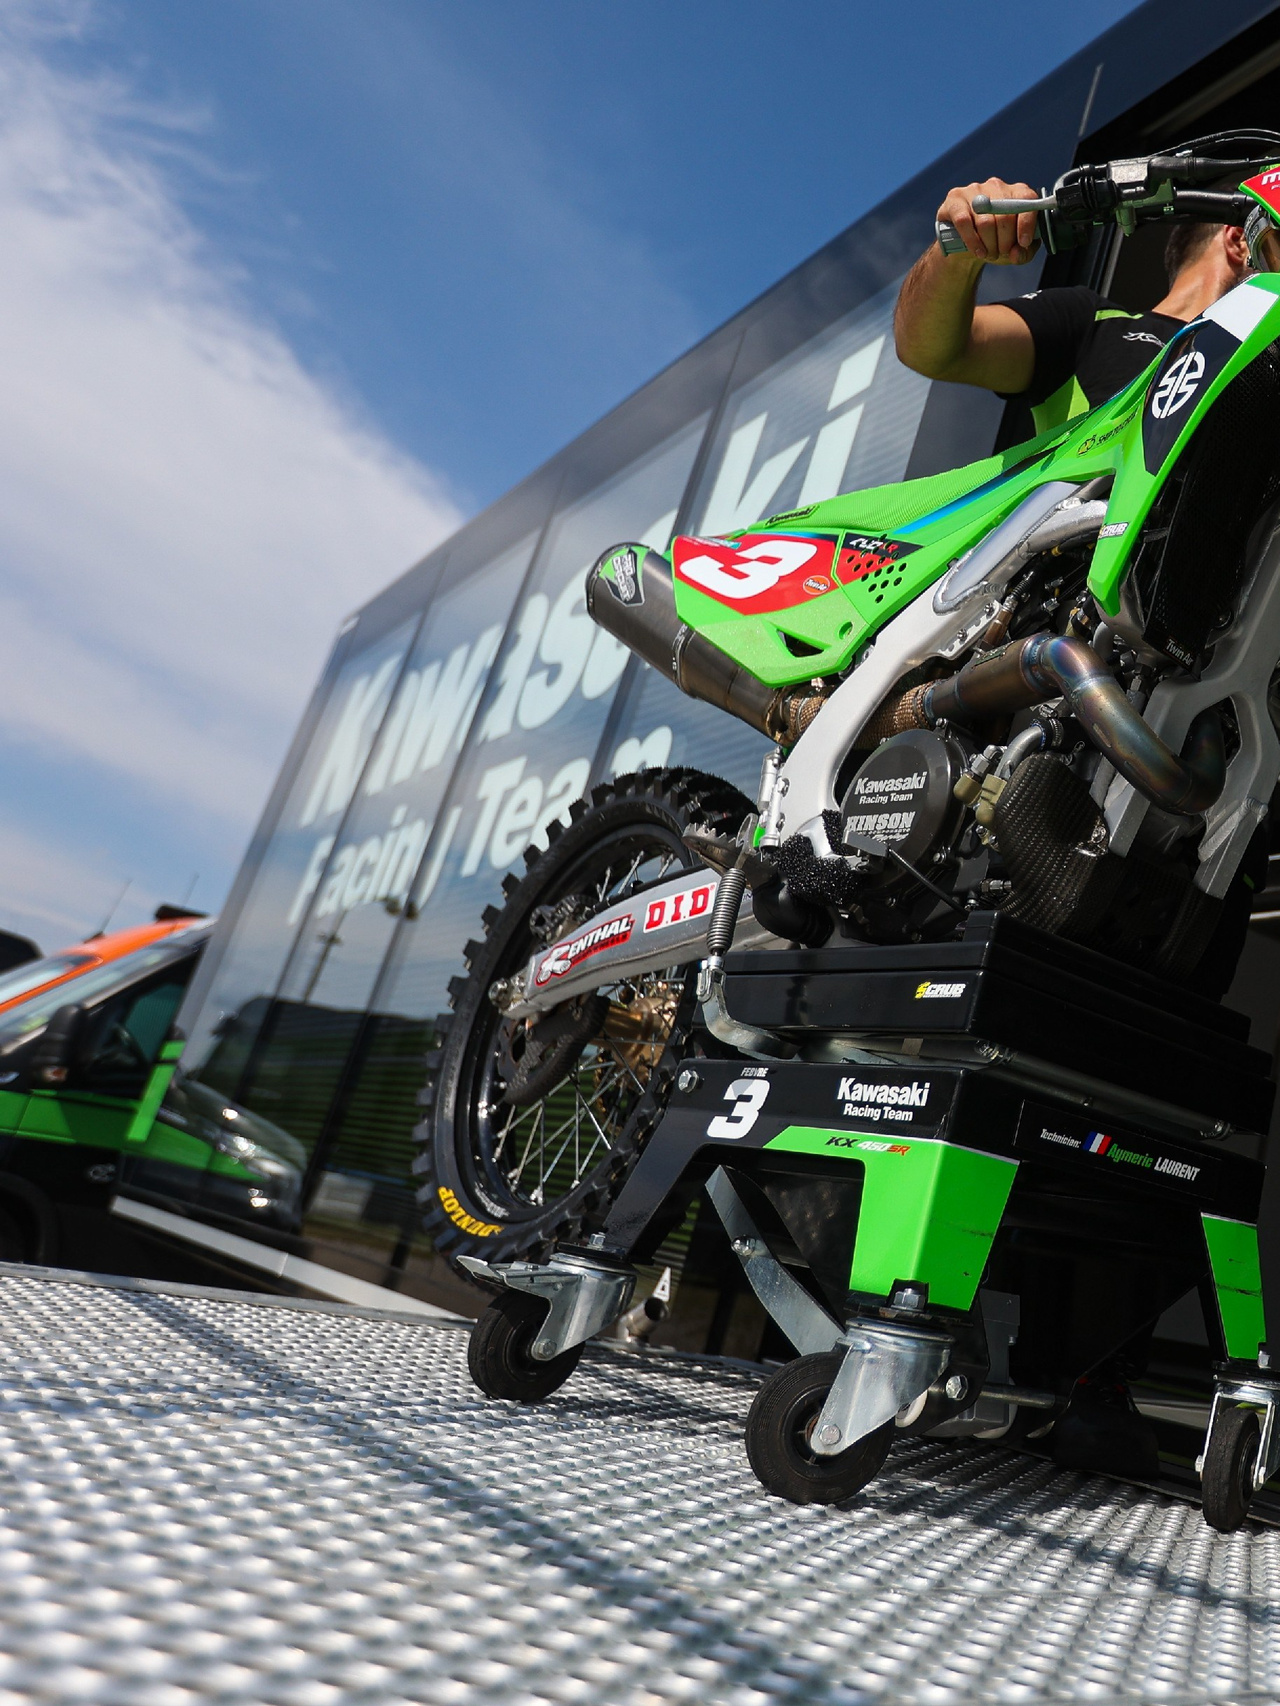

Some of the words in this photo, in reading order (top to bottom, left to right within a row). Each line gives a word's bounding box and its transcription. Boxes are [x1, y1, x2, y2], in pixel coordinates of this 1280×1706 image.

[680, 540, 818, 599] 3
[1164, 638, 1184, 660] Twin
[1182, 651, 1194, 666] Air
[854, 771, 928, 795] Kawasaki
[859, 794, 888, 804] Racing
[890, 792, 914, 802] Team
[846, 810, 916, 832] HINSON
[536, 914, 634, 985] RENTHAL
[914, 981, 967, 998] SCRUB
[740, 1067, 770, 1078] FEBVRE
[837, 1076, 931, 1107] Kawasaki
[706, 1078, 771, 1140] 3
[843, 1103, 881, 1121] Racing
[882, 1106, 914, 1122] Team
[825, 1136, 860, 1148] KX
[1039, 1128, 1082, 1149] Technician:
[1107, 1143, 1154, 1168] Aymeric
[1154, 1156, 1201, 1181] LAURENT
[438, 1186, 503, 1237] DUNLOP
